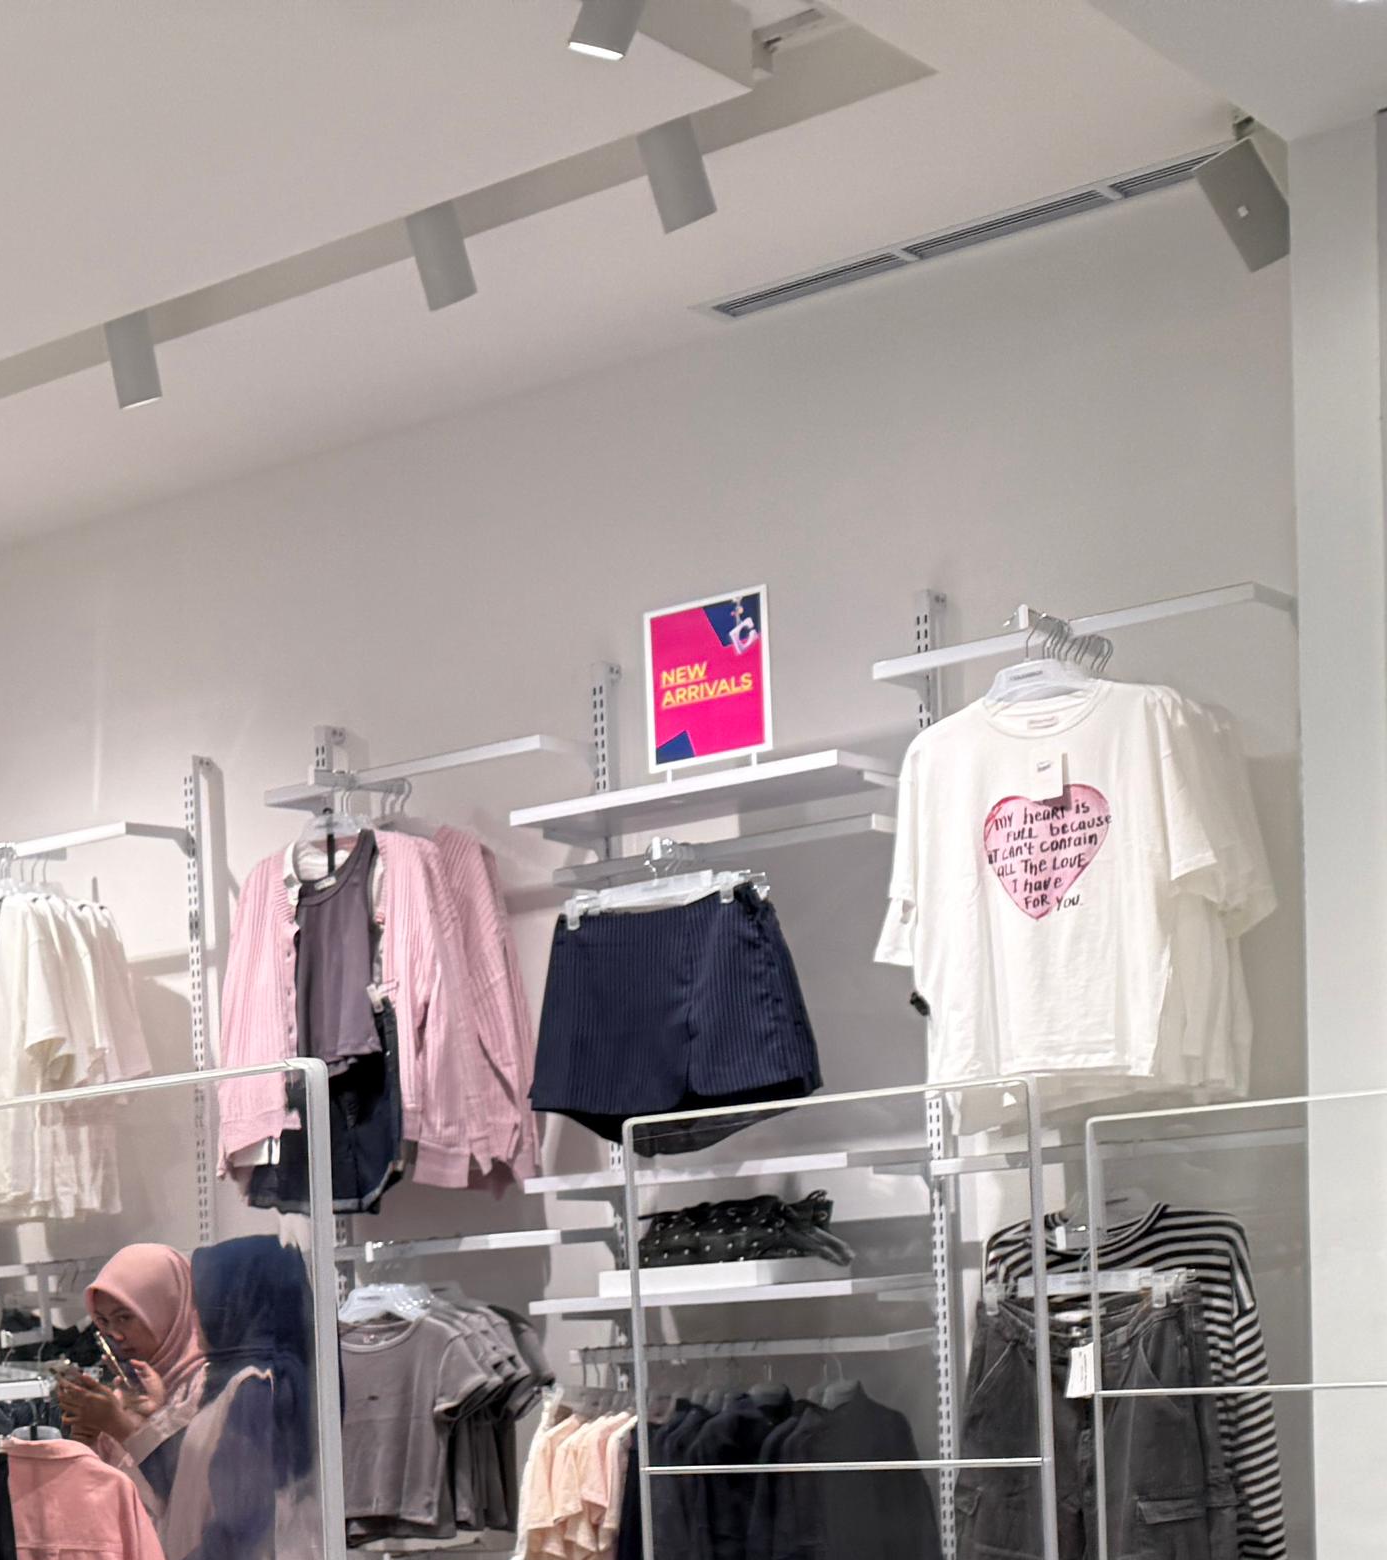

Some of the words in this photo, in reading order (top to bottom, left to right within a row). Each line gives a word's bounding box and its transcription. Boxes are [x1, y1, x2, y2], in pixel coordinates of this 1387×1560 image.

[661, 661, 707, 687] NEW
[662, 672, 753, 708] ARRIVALS
[1050, 815, 1112, 836] because
[1012, 878, 1018, 893] I
[1024, 877, 1063, 894] have
